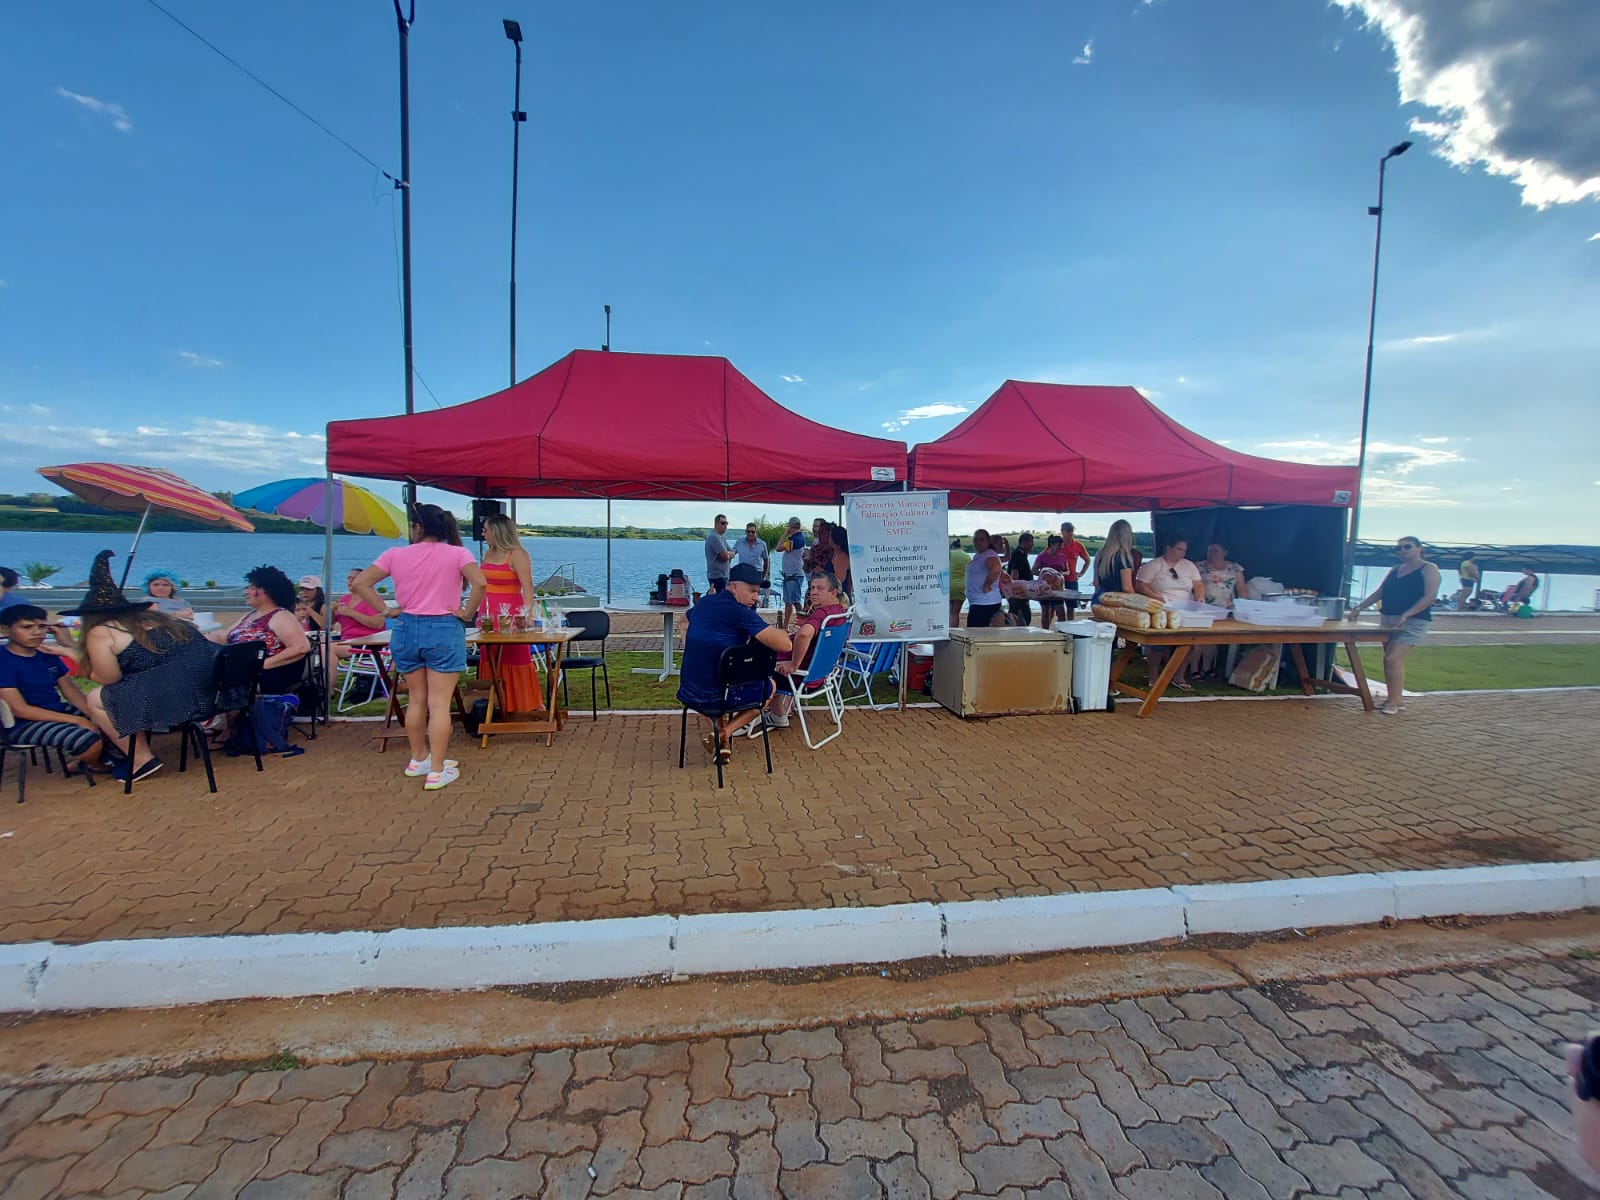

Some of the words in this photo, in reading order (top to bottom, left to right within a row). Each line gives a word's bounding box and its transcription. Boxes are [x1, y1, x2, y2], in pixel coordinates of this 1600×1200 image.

[896, 499, 934, 508] Municipa
[912, 545, 928, 553] gera
[873, 554, 926, 563] conhecimento,
[866, 565, 918, 573] conhecimento
[919, 565, 934, 573] gera
[859, 575, 895, 584] sabedoria
[926, 574, 942, 582] povo
[885, 584, 904, 593] pode
[905, 583, 928, 591] mudar
